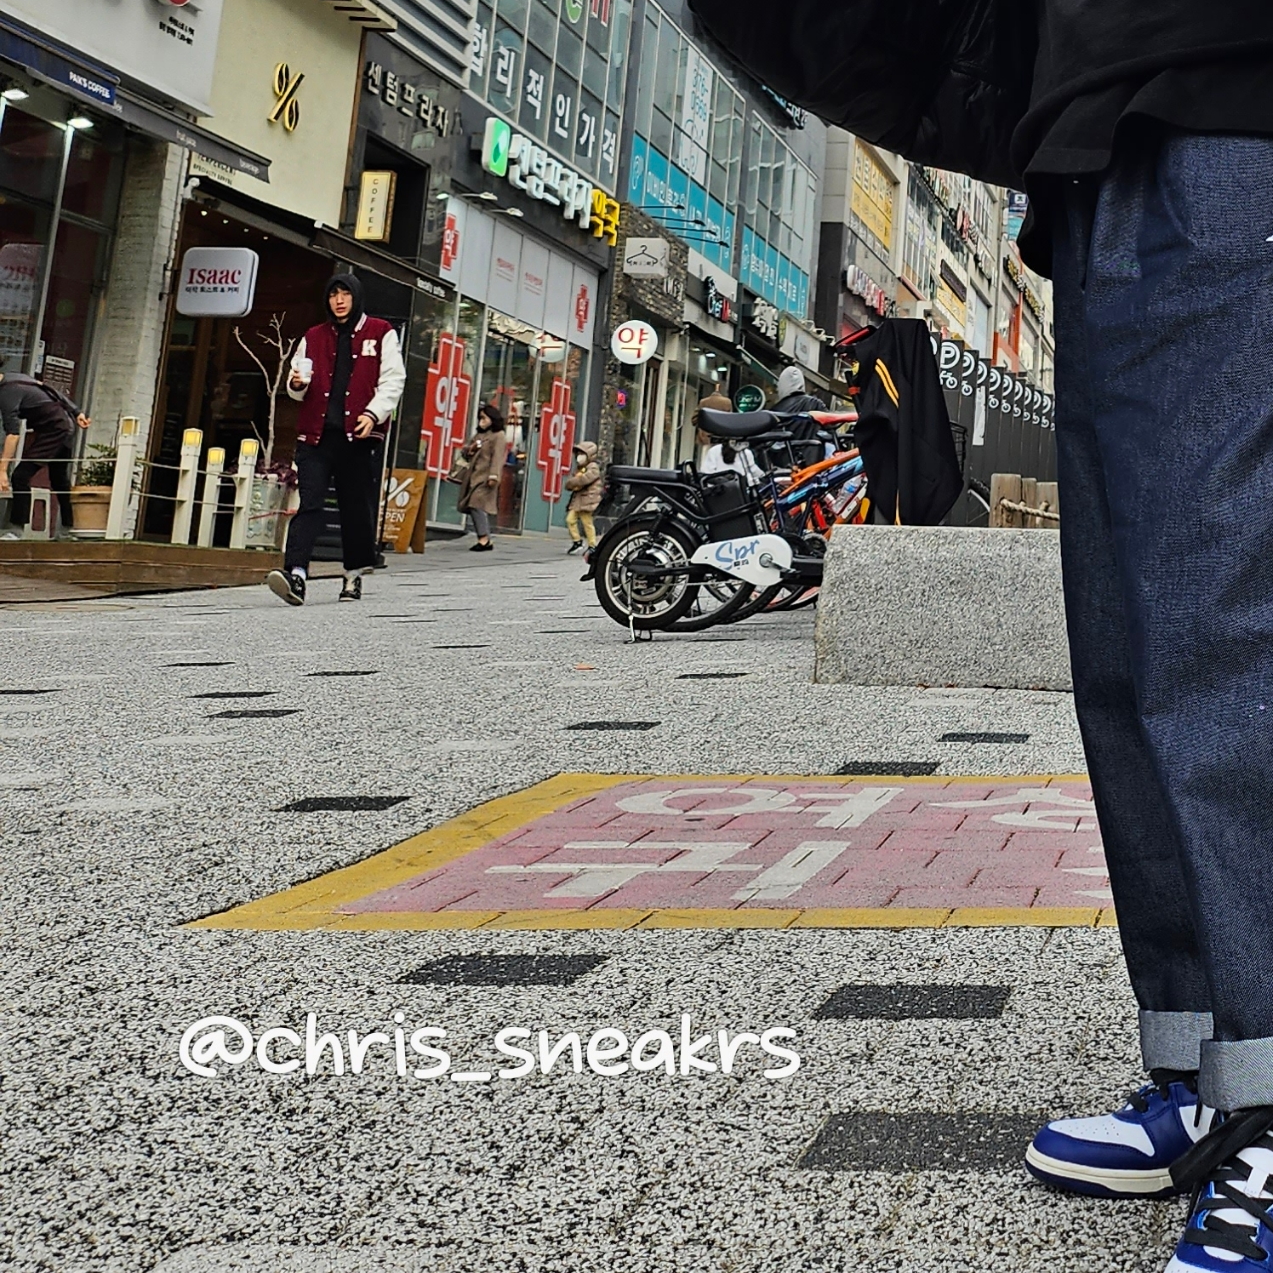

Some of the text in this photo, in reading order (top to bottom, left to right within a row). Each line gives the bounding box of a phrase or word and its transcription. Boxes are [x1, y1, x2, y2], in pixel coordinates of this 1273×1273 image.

[367, 61, 449, 138] 센텀프라자
[580, 116, 617, 174] 가격
[366, 177, 380, 235] COFFEE
[590, 189, 620, 247] 약국
[187, 268, 242, 285] Isaac
[362, 339, 378, 357] K
[618, 326, 649, 358] 약
[436, 377, 459, 446] 약
[549, 415, 567, 475] 약
